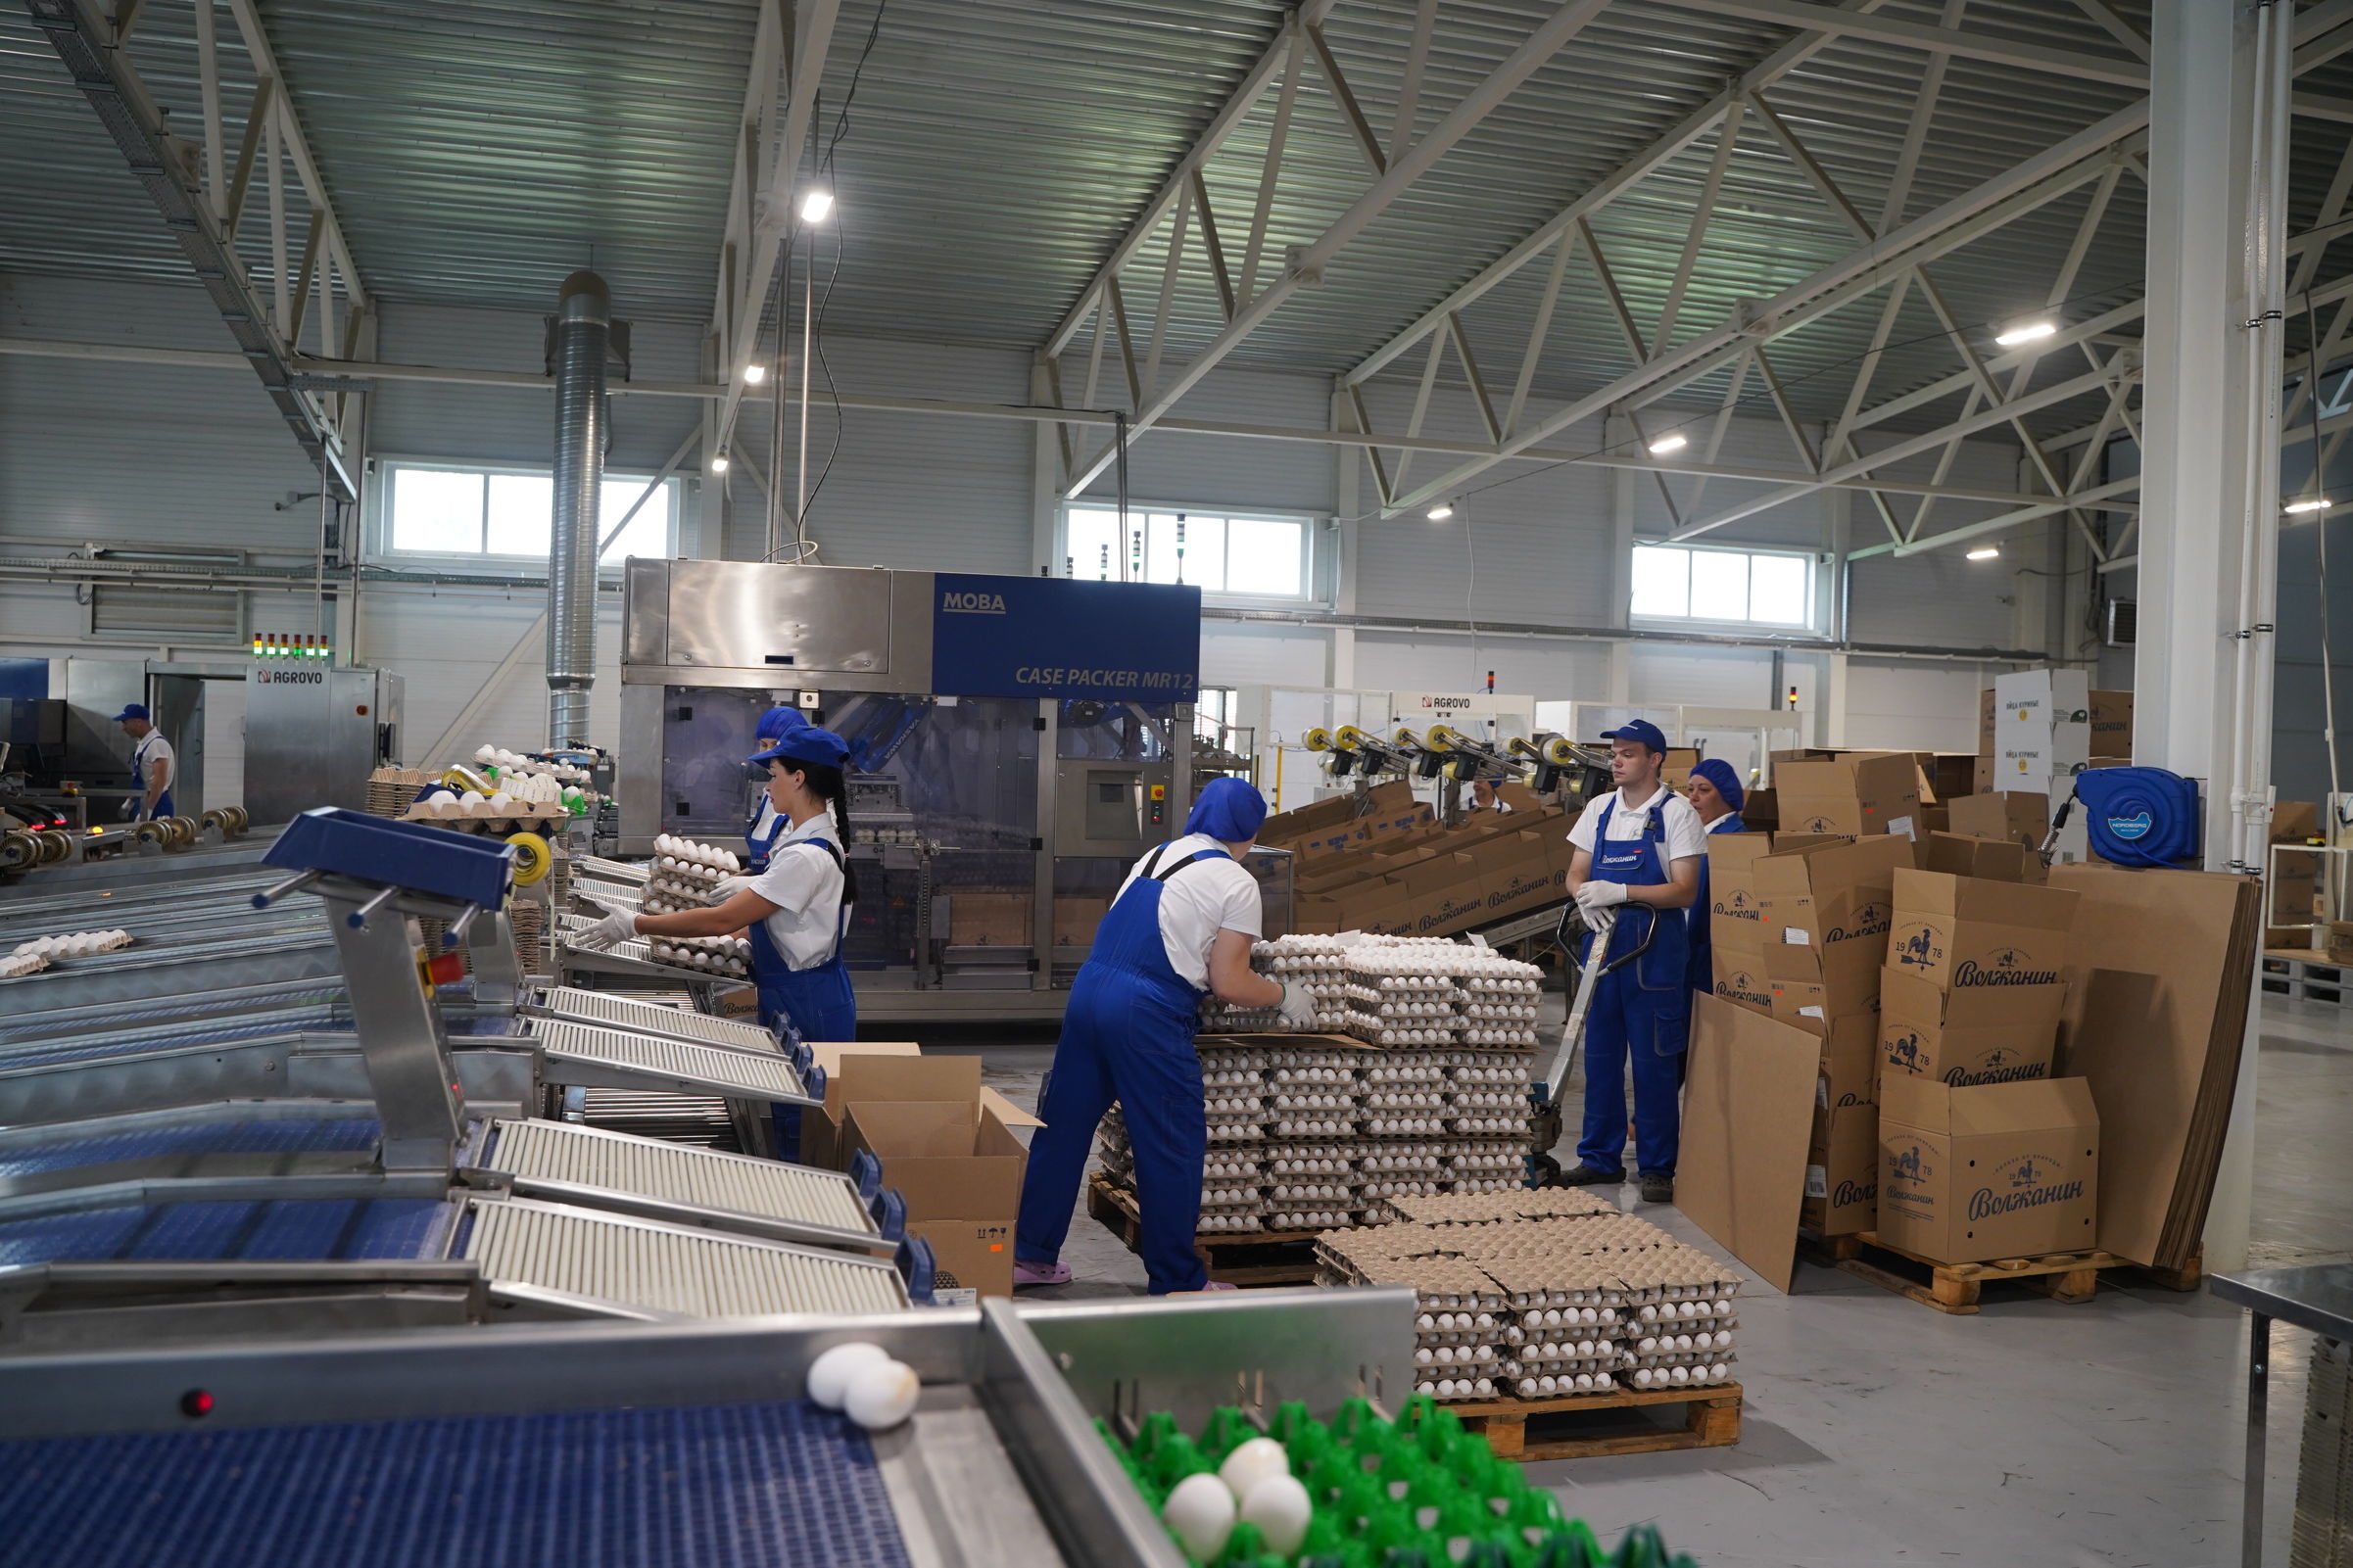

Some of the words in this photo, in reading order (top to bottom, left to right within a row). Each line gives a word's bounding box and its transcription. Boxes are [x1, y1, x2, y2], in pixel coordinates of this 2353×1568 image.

[943, 592, 1006, 611] MOBA
[273, 671, 322, 685] AGROVO
[1016, 667, 1065, 685] CASE
[1067, 668, 1138, 688] PACKER
[1142, 672, 1193, 689] MR12
[1434, 697, 1470, 709] AGROVO
[1487, 876, 1549, 909] Волжанин
[1418, 897, 1481, 931] Волжанин
[1896, 941, 1905, 952] 19
[1932, 948, 1943, 959] 78
[1954, 960, 2057, 987] Волжанин
[1884, 1040, 1894, 1052] 19
[1919, 1054, 1930, 1067] 78
[1888, 1156, 1897, 1166] 19
[1922, 1165, 1933, 1176] 78
[1887, 1184, 1935, 1206] Волжанин
[1968, 1179, 2085, 1221] Волжанин
